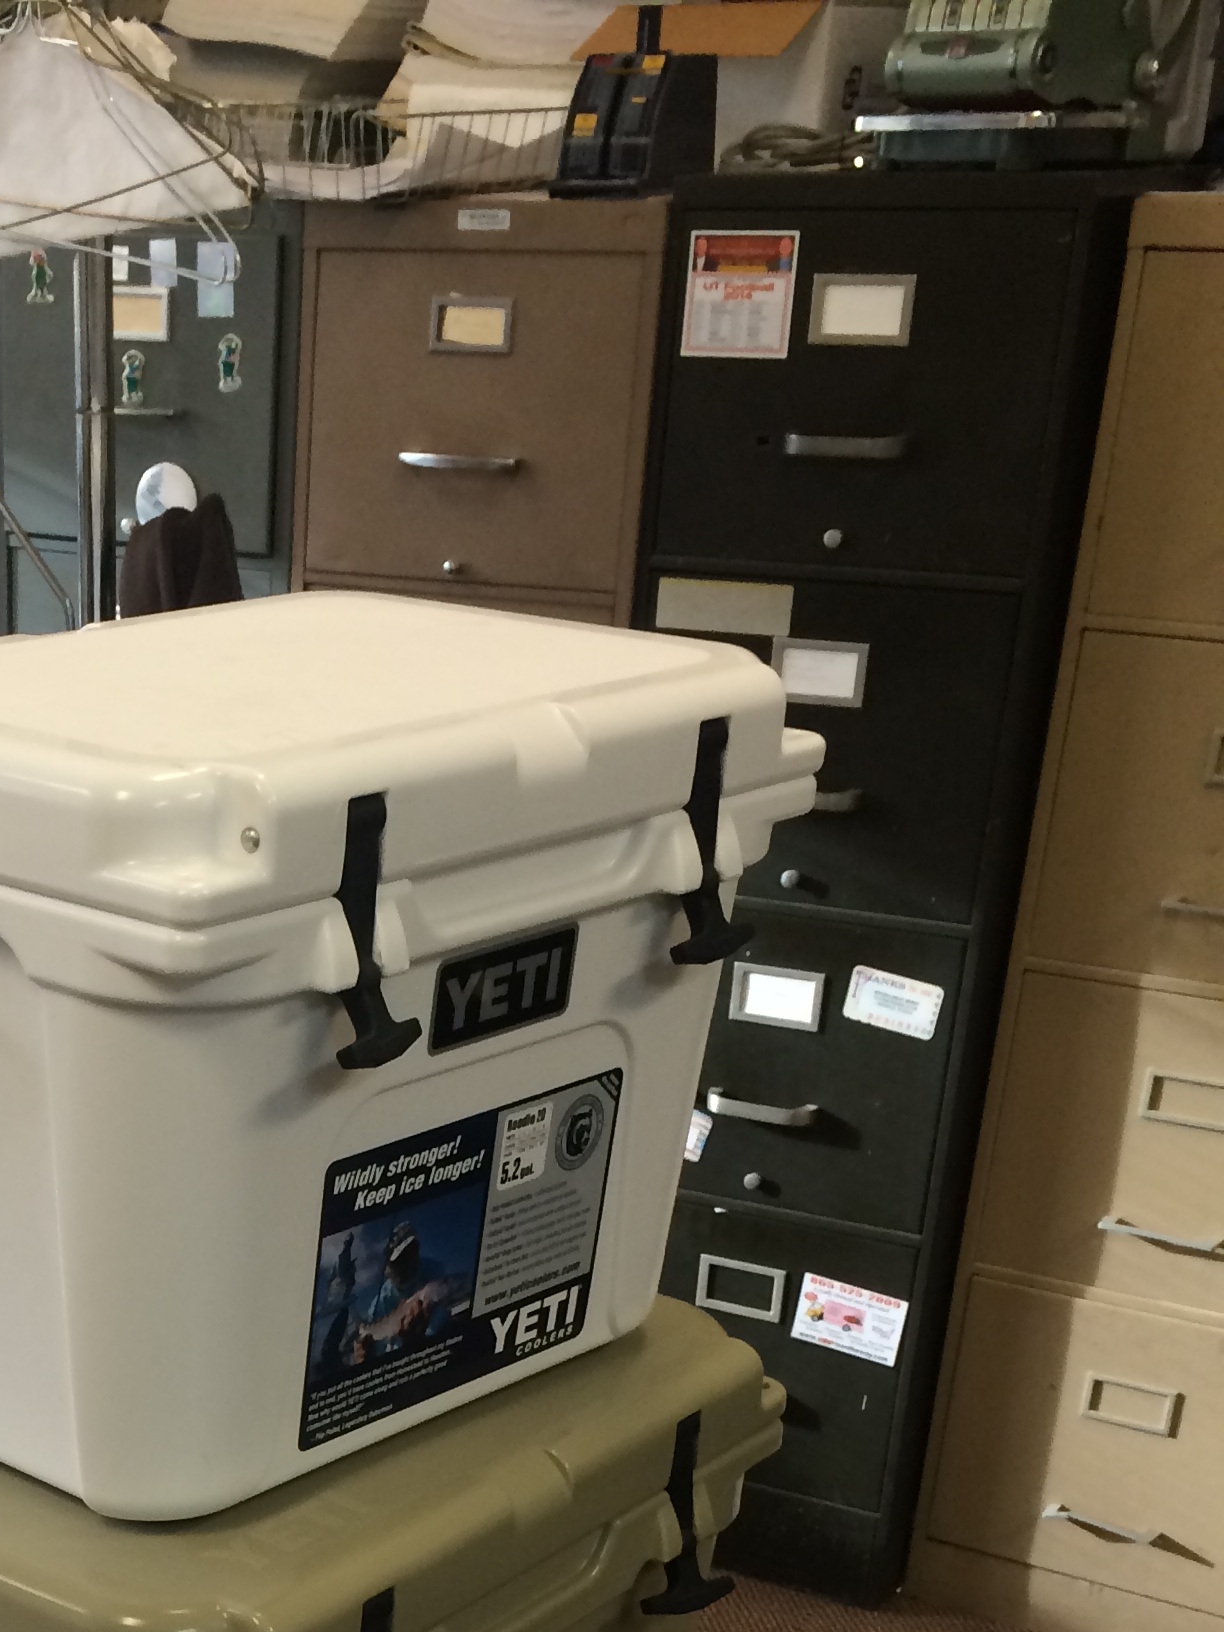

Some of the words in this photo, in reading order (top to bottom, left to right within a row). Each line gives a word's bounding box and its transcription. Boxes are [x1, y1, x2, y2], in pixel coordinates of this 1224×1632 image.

[445, 947, 564, 1031] YETI
[333, 1163, 384, 1194] Wildly
[387, 1135, 461, 1176] stronger!
[354, 1184, 396, 1210] Keep
[399, 1174, 425, 1195] ice
[428, 1149, 485, 1185] longer!
[500, 1157, 521, 1184] 5.2
[490, 1285, 578, 1353] YETI
[516, 1324, 573, 1356] COOLERS
